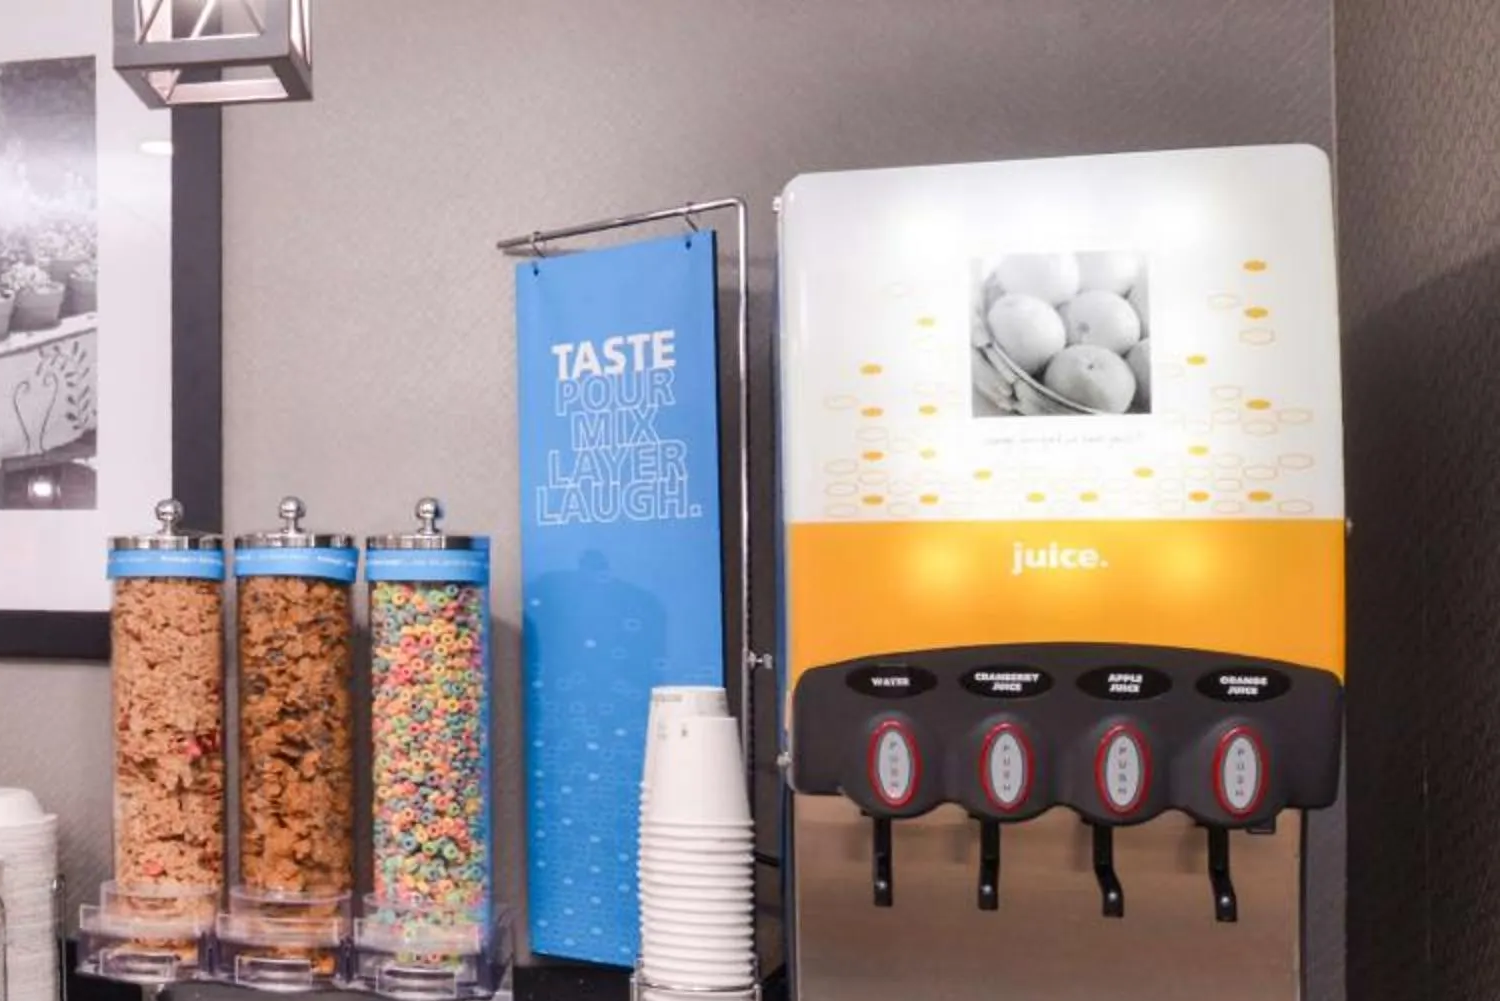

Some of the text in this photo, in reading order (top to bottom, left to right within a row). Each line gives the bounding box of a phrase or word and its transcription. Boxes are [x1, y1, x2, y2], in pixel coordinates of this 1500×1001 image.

[551, 329, 676, 382] TASTE
[555, 367, 676, 417] POUR
[570, 406, 660, 451] MIX
[548, 439, 688, 488] LAYER
[535, 476, 703, 527] LAUGH.
[1011, 541, 1109, 577] juice.
[871, 676, 911, 688] WATER
[974, 671, 1041, 683] CRANBERRY
[1107, 673, 1144, 684] APPLE
[1219, 675, 1269, 686] ORANGE
[992, 682, 1023, 692] JUICE
[1108, 683, 1141, 694] JUICE
[1227, 685, 1259, 696] JUICE
